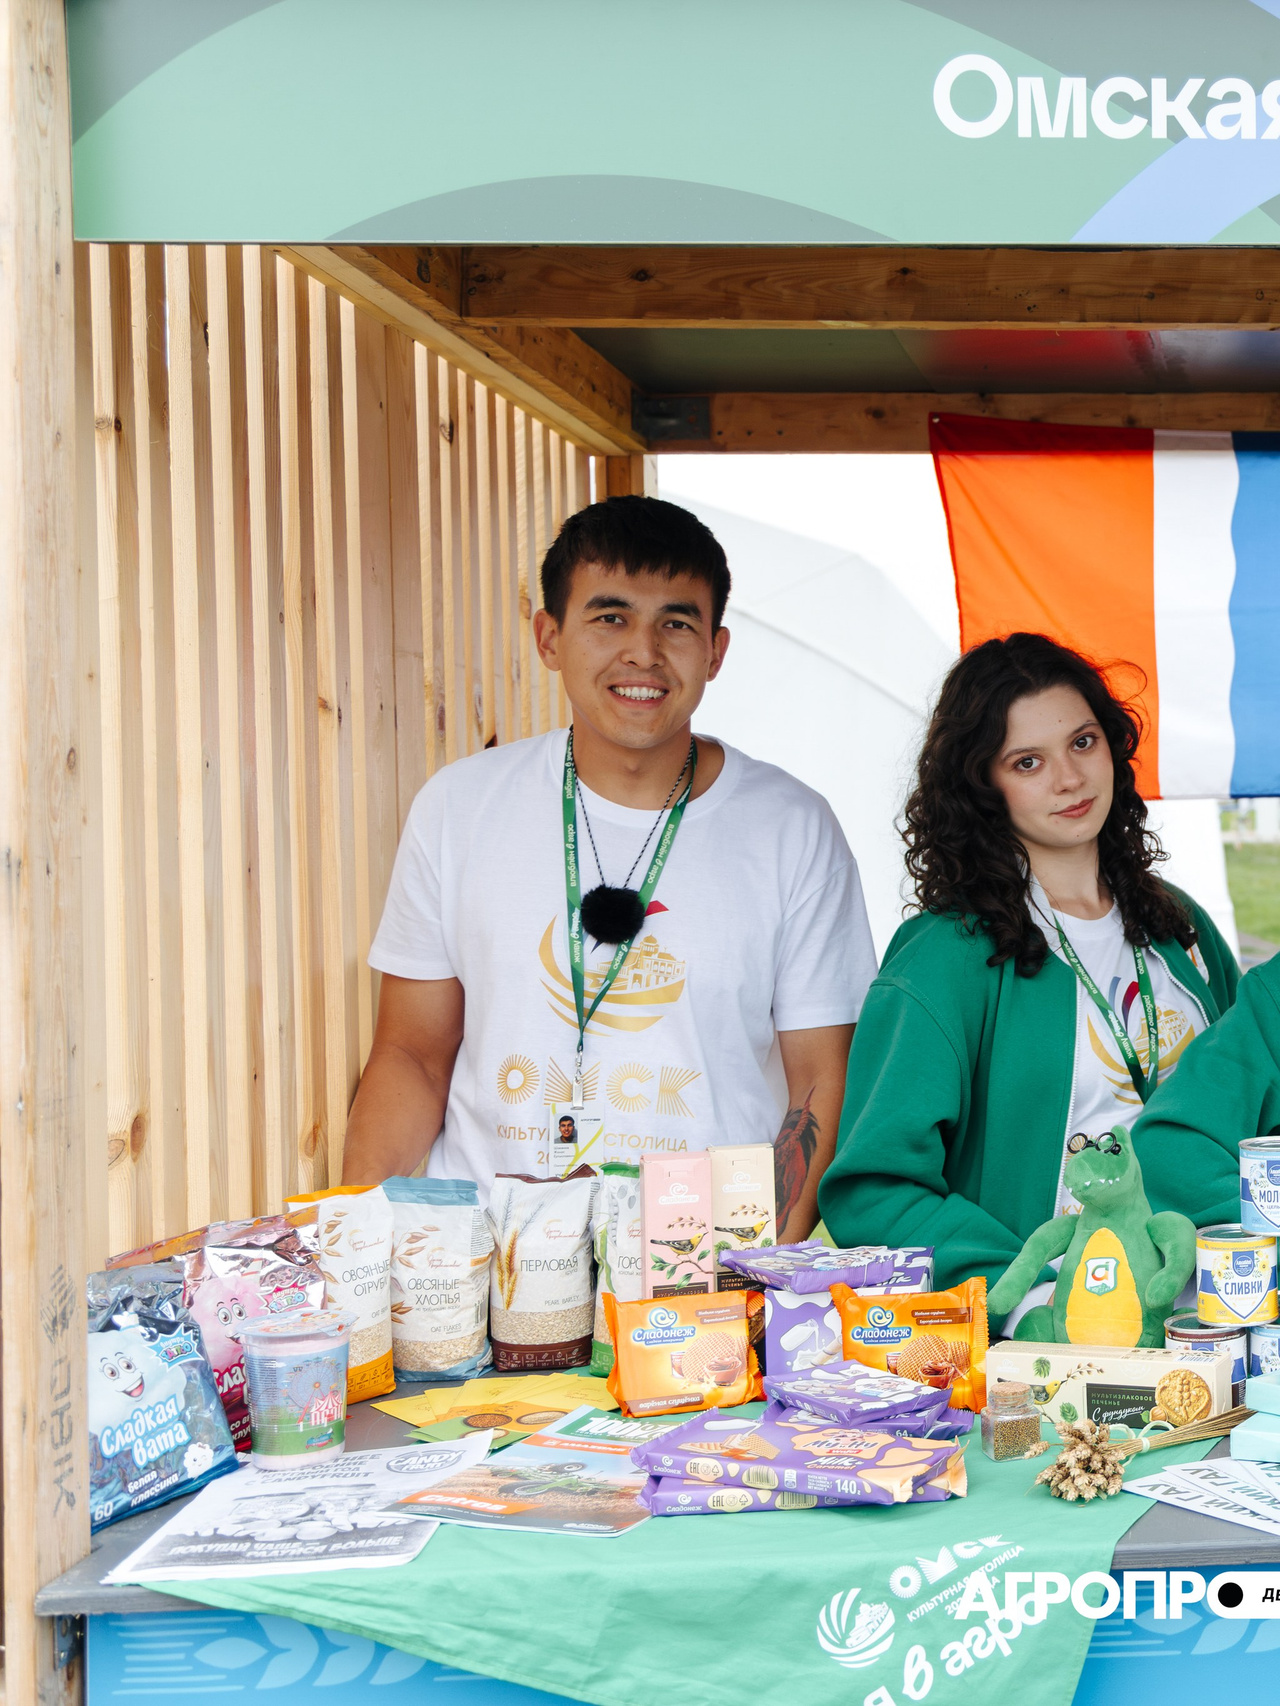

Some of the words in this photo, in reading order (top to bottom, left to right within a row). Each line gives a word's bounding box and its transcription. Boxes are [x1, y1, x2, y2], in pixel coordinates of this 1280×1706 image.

[657, 823, 675, 859] влюблён
[569, 852, 577, 887] влюблён
[647, 866, 659, 884] агро
[613, 951, 624, 970] агро
[1077, 963, 1098, 995] влюблён
[1142, 994, 1155, 1026] работаю
[604, 1132, 689, 1152] СТОЛИЦА
[342, 1258, 391, 1284] ОВСЯНЫЕ
[520, 1256, 579, 1272] ПЕРЛОВАЯ
[407, 1278, 460, 1291] ОВСЯНЫЕ
[1224, 1279, 1263, 1295] СЛИВКИ
[415, 1293, 461, 1306] ХЛОПЬЯ
[443, 1323, 462, 1332] FLAKES
[633, 1326, 695, 1343] Сладонеж
[853, 1327, 910, 1342] Сладонеж
[668, 1394, 700, 1409] сгущёнка
[1091, 1392, 1153, 1402] МУЛЬТИЗЛАКОВОЕ
[1102, 1405, 1146, 1423] фундуком
[101, 1397, 180, 1450] Сладкая
[132, 1424, 191, 1466] вата
[558, 1442, 629, 1453] AMAZONE
[388, 1450, 467, 1467] CANDY
[804, 1456, 856, 1465] Milk
[806, 1463, 856, 1471] Caramel
[260, 1471, 374, 1484] CANDYFRUIT
[653, 1465, 682, 1475] Сладонеж
[127, 1469, 158, 1494] белая
[130, 1472, 179, 1508] классика
[835, 1479, 857, 1495] 140
[666, 1504, 702, 1513] Сладонеж
[712, 1496, 724, 1508] EAC
[94, 1502, 114, 1521] 60
[168, 1542, 252, 1556] ПОКУПАЙ
[329, 1535, 404, 1552] БОЛЬШЕ
[889, 1534, 1016, 1598] ОМСК
[902, 1644, 934, 1701] в
